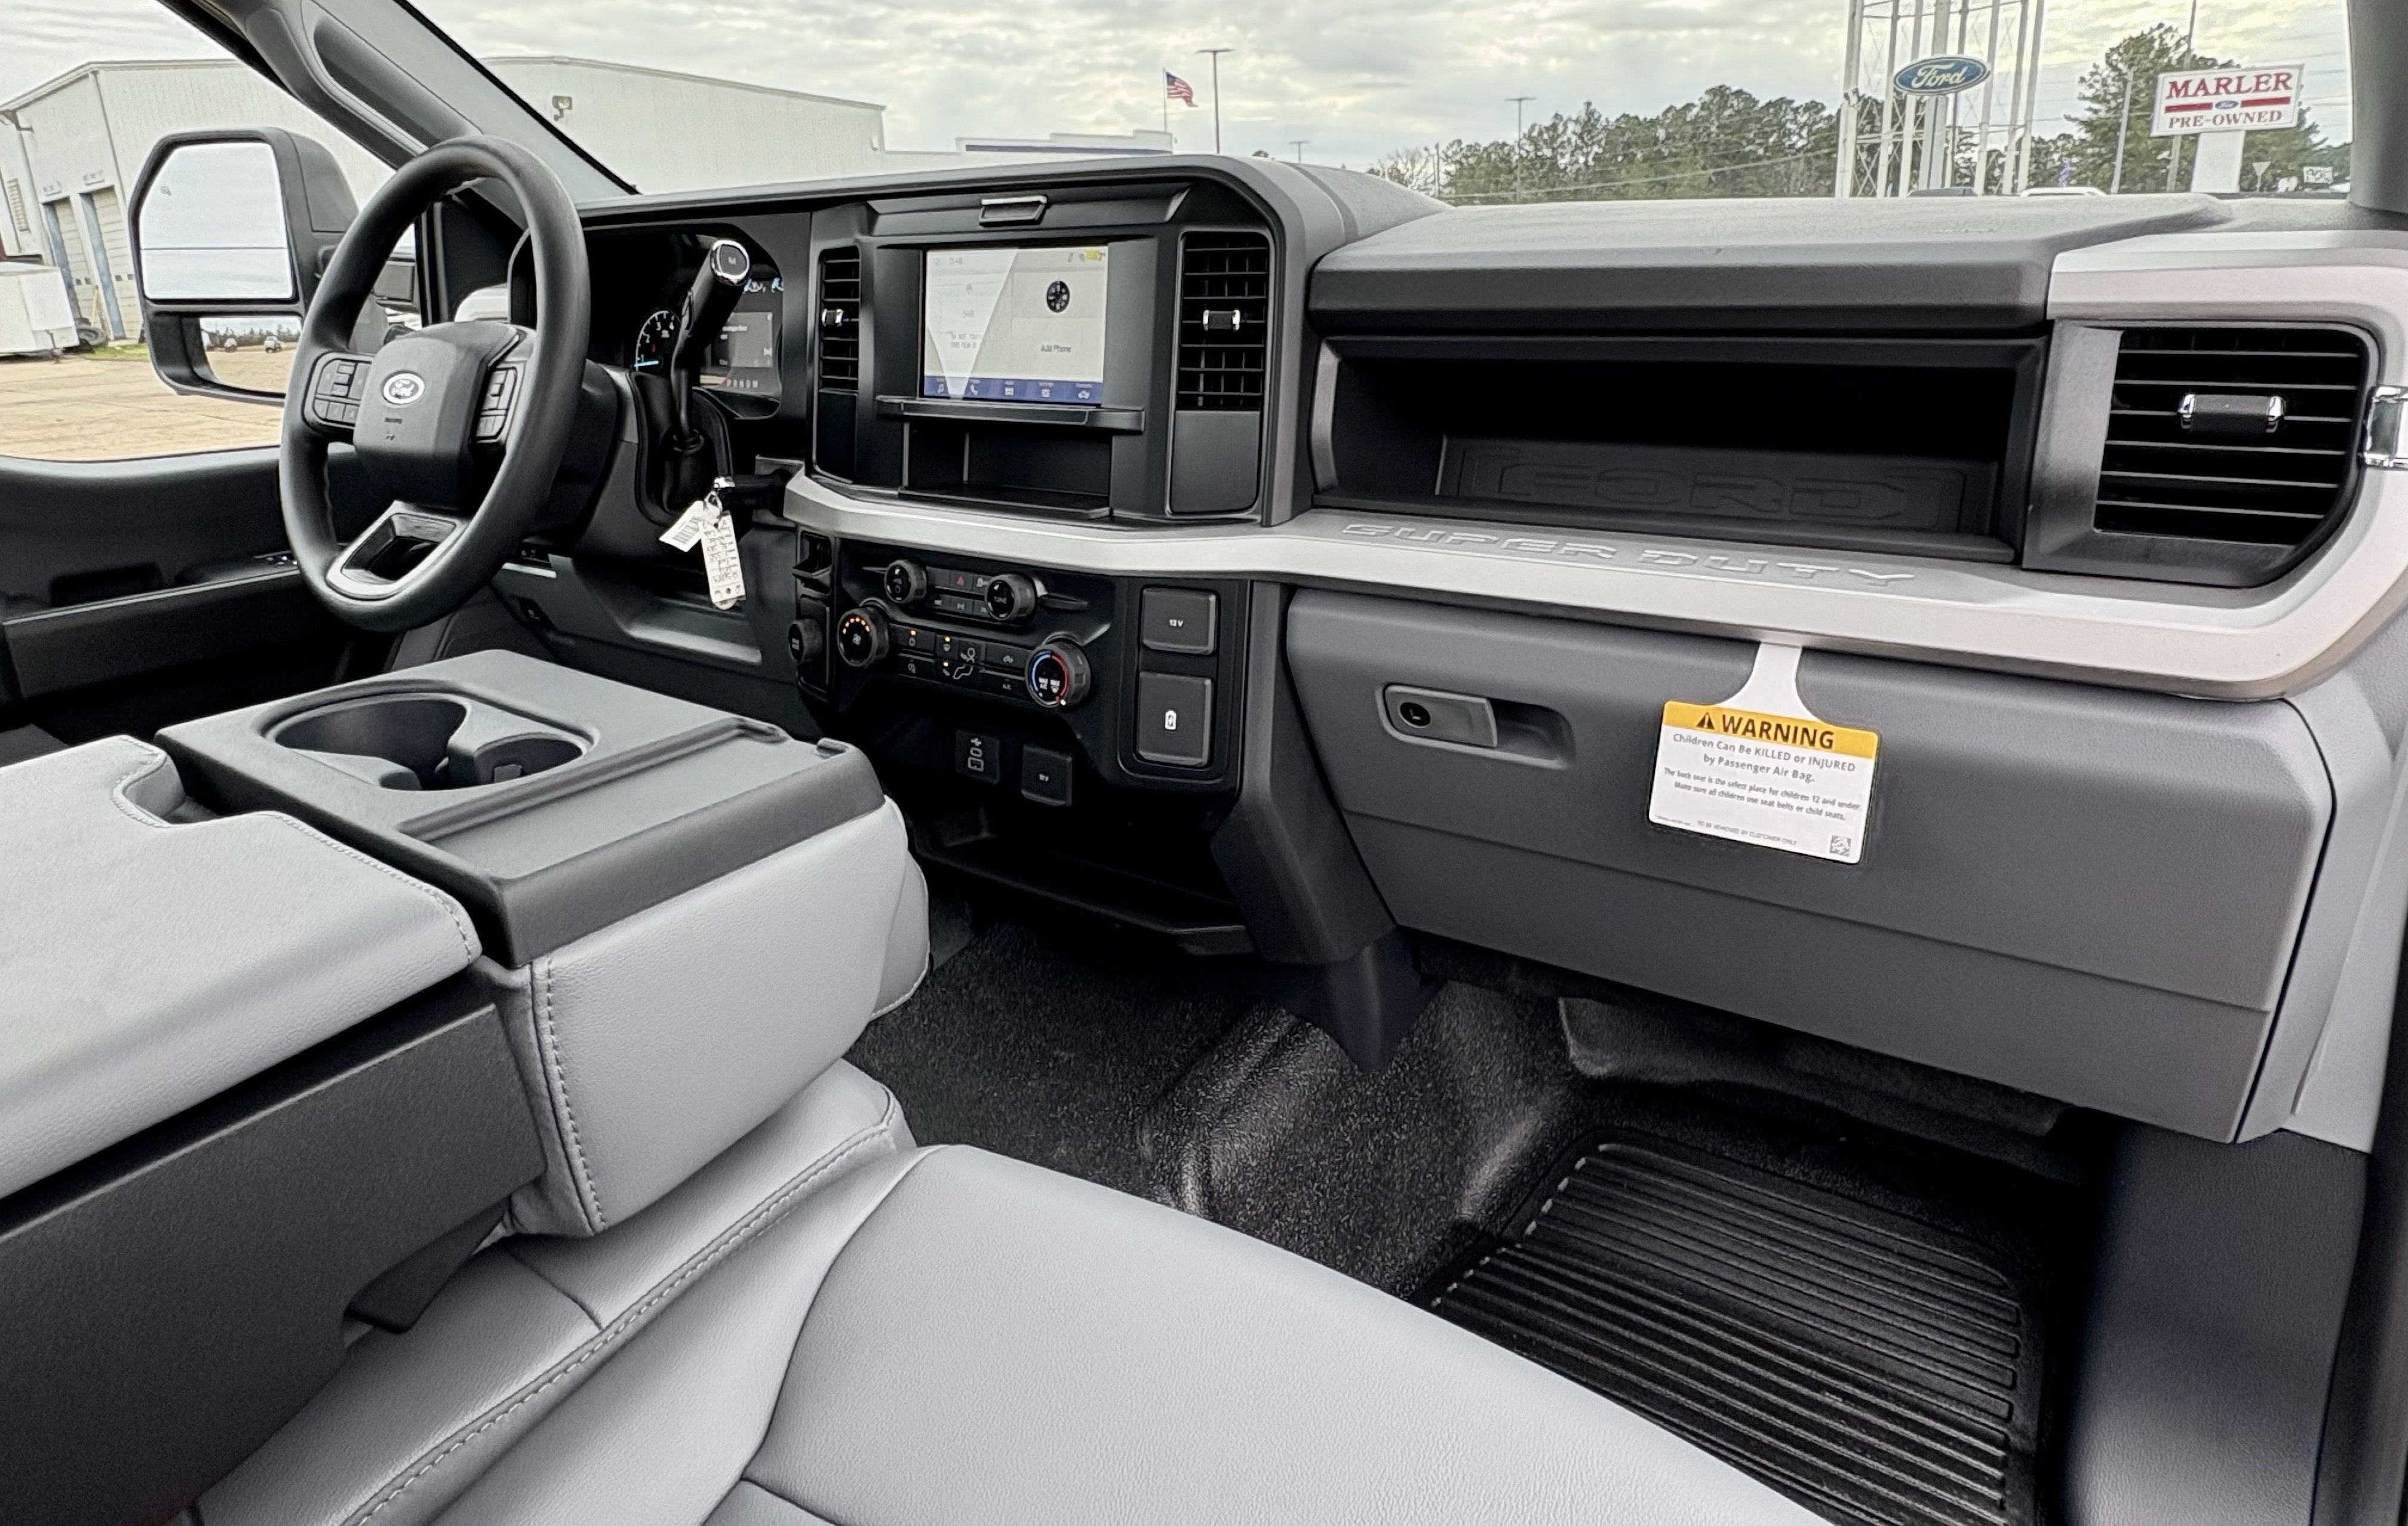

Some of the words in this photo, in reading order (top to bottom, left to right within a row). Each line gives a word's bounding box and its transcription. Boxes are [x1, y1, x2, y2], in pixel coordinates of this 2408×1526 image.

[1911, 63, 1968, 88] Ford
[2166, 72, 2293, 100] MARLER
[2168, 110, 2283, 129] PRE-OWNED
[1054, 344, 1071, 353] Phone
[1498, 463, 1905, 521] FORD
[1342, 523, 1618, 560] SUPER
[1643, 549, 1917, 586] DUTY
[1722, 714, 1835, 749] WARNING
[1673, 733, 1714, 748] Children
[1716, 740, 1736, 752] Can
[1739, 744, 1752, 755] Be
[1755, 747, 1791, 761] KILLED
[1793, 755, 1806, 764] or
[1808, 756, 1856, 771] INJURED
[1703, 753, 1715, 765] by
[1718, 756, 1771, 774] Passenger
[1773, 766, 1789, 777] Air
[1792, 770, 1815, 783] Bag.
[1664, 767, 1675, 776] The
[1715, 777, 1725, 786] the
[1728, 780, 1747, 790] safest
[1748, 784, 1767, 794] place
[1769, 787, 1779, 795] for
[1781, 789, 1810, 801] children
[1812, 795, 1820, 804] 12
[1718, 789, 1745, 801] children
[1777, 801, 1794, 811] belts
[1805, 807, 1823, 816] child
